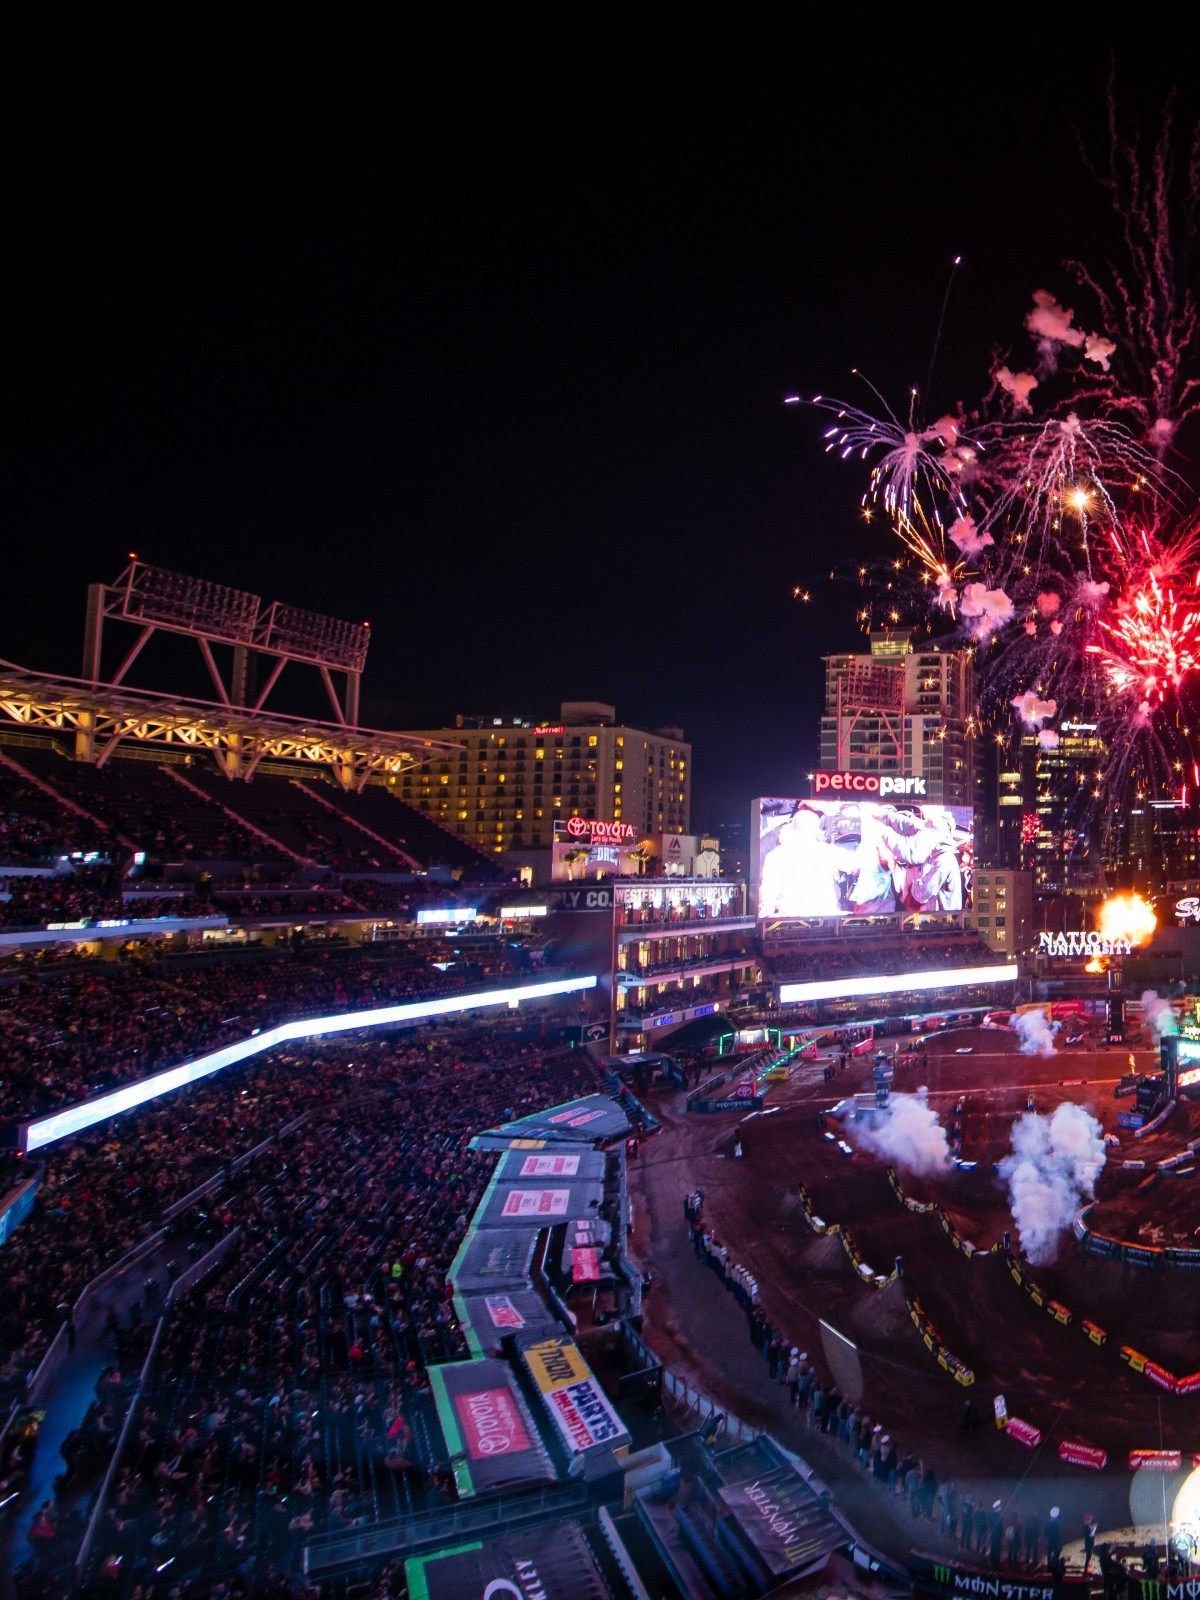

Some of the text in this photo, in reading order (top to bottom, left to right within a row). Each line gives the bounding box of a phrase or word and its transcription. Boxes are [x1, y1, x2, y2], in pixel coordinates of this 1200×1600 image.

[589, 821, 635, 838] TOYOTA
[615, 887, 663, 903] WESTERN
[665, 887, 693, 901] METAL
[696, 887, 727, 900] SUPPLY
[1047, 944, 1133, 956] UNIVERSITY
[539, 1347, 576, 1383] THOR
[468, 1393, 499, 1437] TOYOTA
[551, 1389, 594, 1448] UNLIMITED
[567, 1381, 620, 1441] PARTS
[1068, 1457, 1100, 1469] HONDA
[1141, 1459, 1178, 1467] HONDA
[744, 1481, 800, 1545] MONSTER
[954, 1574, 1054, 1600] MONSTER
